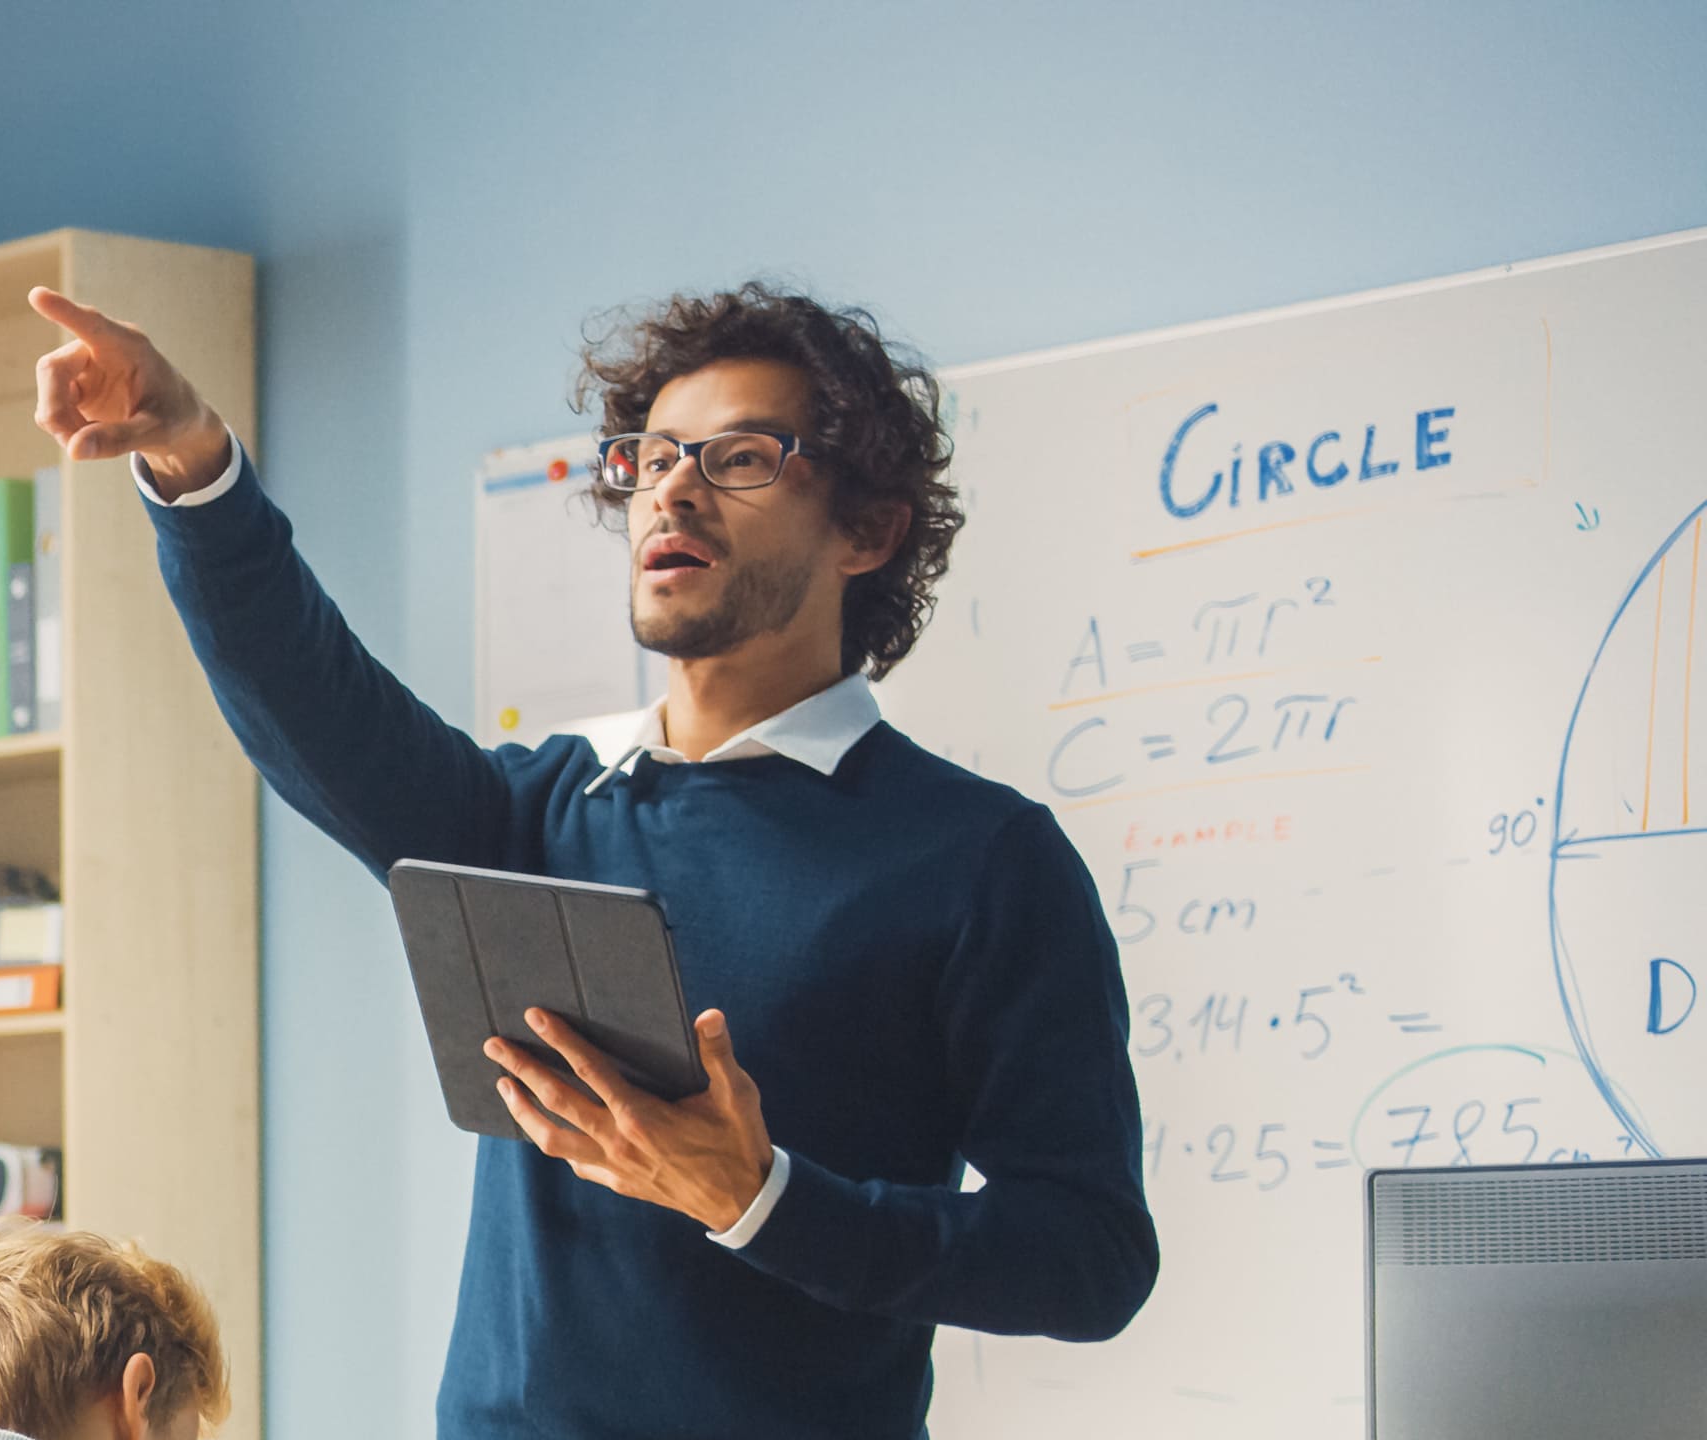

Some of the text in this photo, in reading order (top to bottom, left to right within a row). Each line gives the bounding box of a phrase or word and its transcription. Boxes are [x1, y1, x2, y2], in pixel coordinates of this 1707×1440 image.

[1060, 615, 1106, 694] A
[1047, 717, 1125, 798] C
[1116, 859, 1256, 944] 5 cm
[1647, 957, 1696, 1035] D
